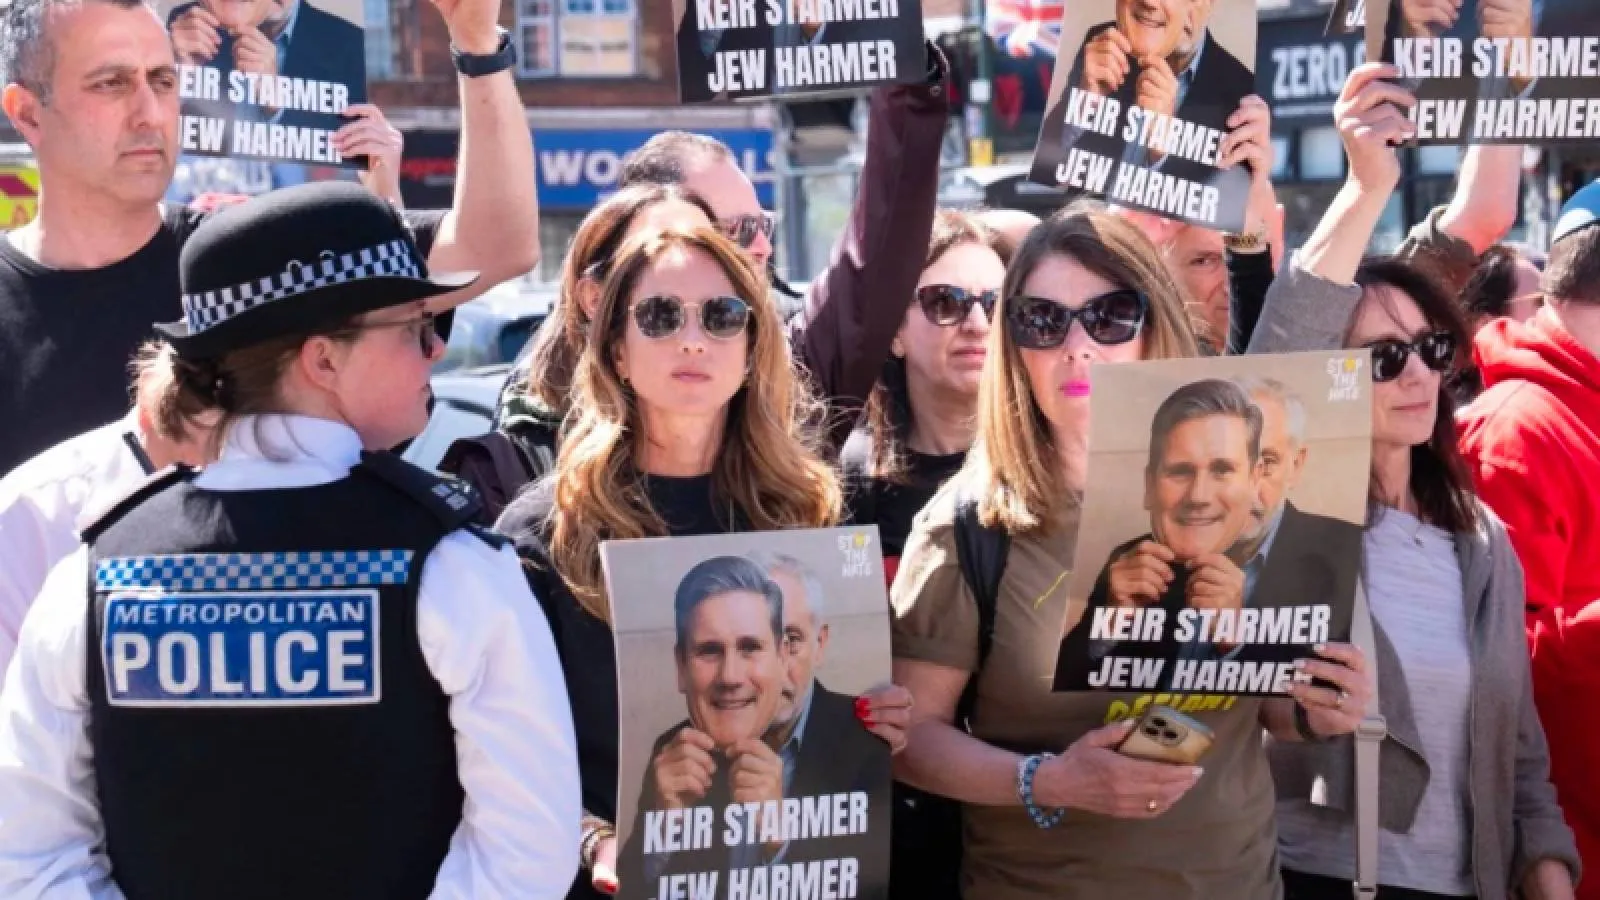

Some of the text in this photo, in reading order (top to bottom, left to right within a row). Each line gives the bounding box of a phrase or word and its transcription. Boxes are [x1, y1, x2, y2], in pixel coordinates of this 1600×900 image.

[697, 0, 756, 31] KEIR
[708, 40, 896, 92] JEW HARMER
[1271, 43, 1347, 98] ZERO
[1394, 37, 1462, 77] KEIR
[1471, 37, 1600, 77] STARME
[176, 64, 349, 113] EIR STARMER
[179, 115, 226, 151] EW
[1064, 86, 1228, 167] KEIR STARME
[1411, 99, 1600, 139] EW HARMER
[1056, 147, 1219, 223] JEW HARMER
[113, 600, 366, 625] METROPOLITAN
[1089, 604, 1331, 644] KEIR STARMER
[112, 630, 367, 694] POLICE
[1088, 657, 1165, 688] JEW
[643, 791, 869, 855] KEIR STARMER
[728, 857, 859, 900] HARMER
